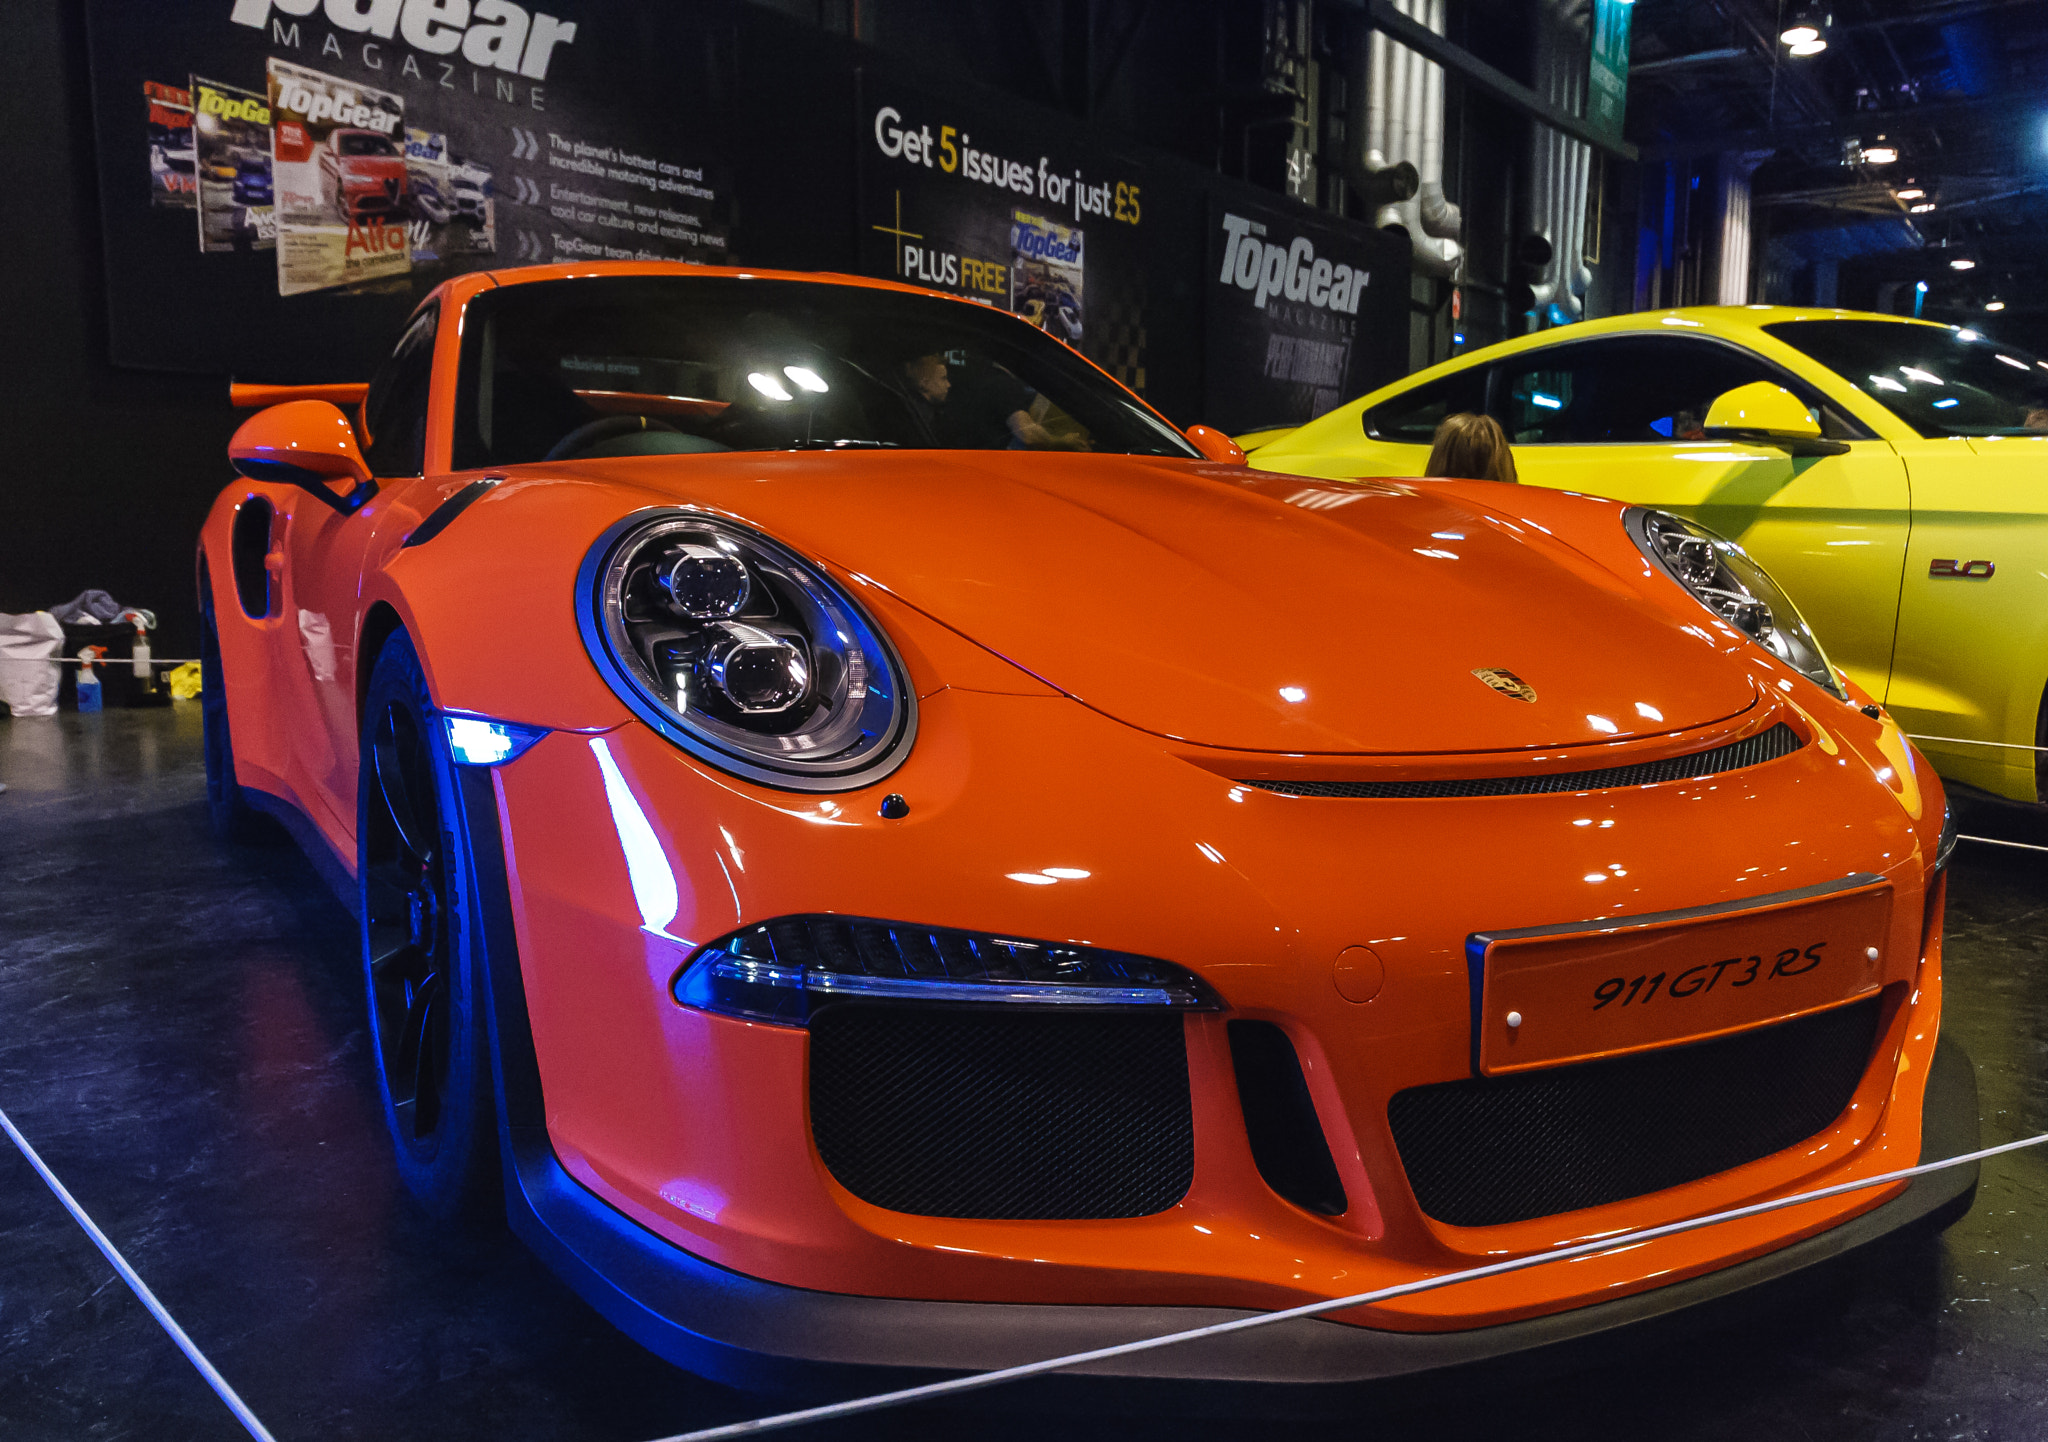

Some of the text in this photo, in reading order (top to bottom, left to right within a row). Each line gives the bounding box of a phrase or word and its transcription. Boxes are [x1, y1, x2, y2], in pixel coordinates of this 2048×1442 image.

[272, 17, 545, 112] MAGAZINE
[199, 86, 270, 125] TopGe
[276, 75, 401, 134] TopGear
[548, 132, 703, 182] The planet's hottest cars and
[874, 106, 1141, 225] Get 5 issues for just £5
[608, 167, 657, 192] motoring
[658, 176, 714, 200] adventures
[551, 205, 726, 248] cool car culture and exciting news
[633, 203, 657, 218] new
[345, 216, 405, 256] Alfa
[552, 233, 603, 254] TopGear
[605, 245, 634, 261] team
[1016, 221, 1080, 264] TopGear
[904, 245, 1007, 294] PLUS FREE
[1219, 212, 1370, 314] TopGear
[1268, 302, 1356, 336] MAGAZINE
[1929, 558, 1996, 579] 5.0
[1593, 971, 1667, 1011] 911
[1768, 941, 1828, 981] RS
